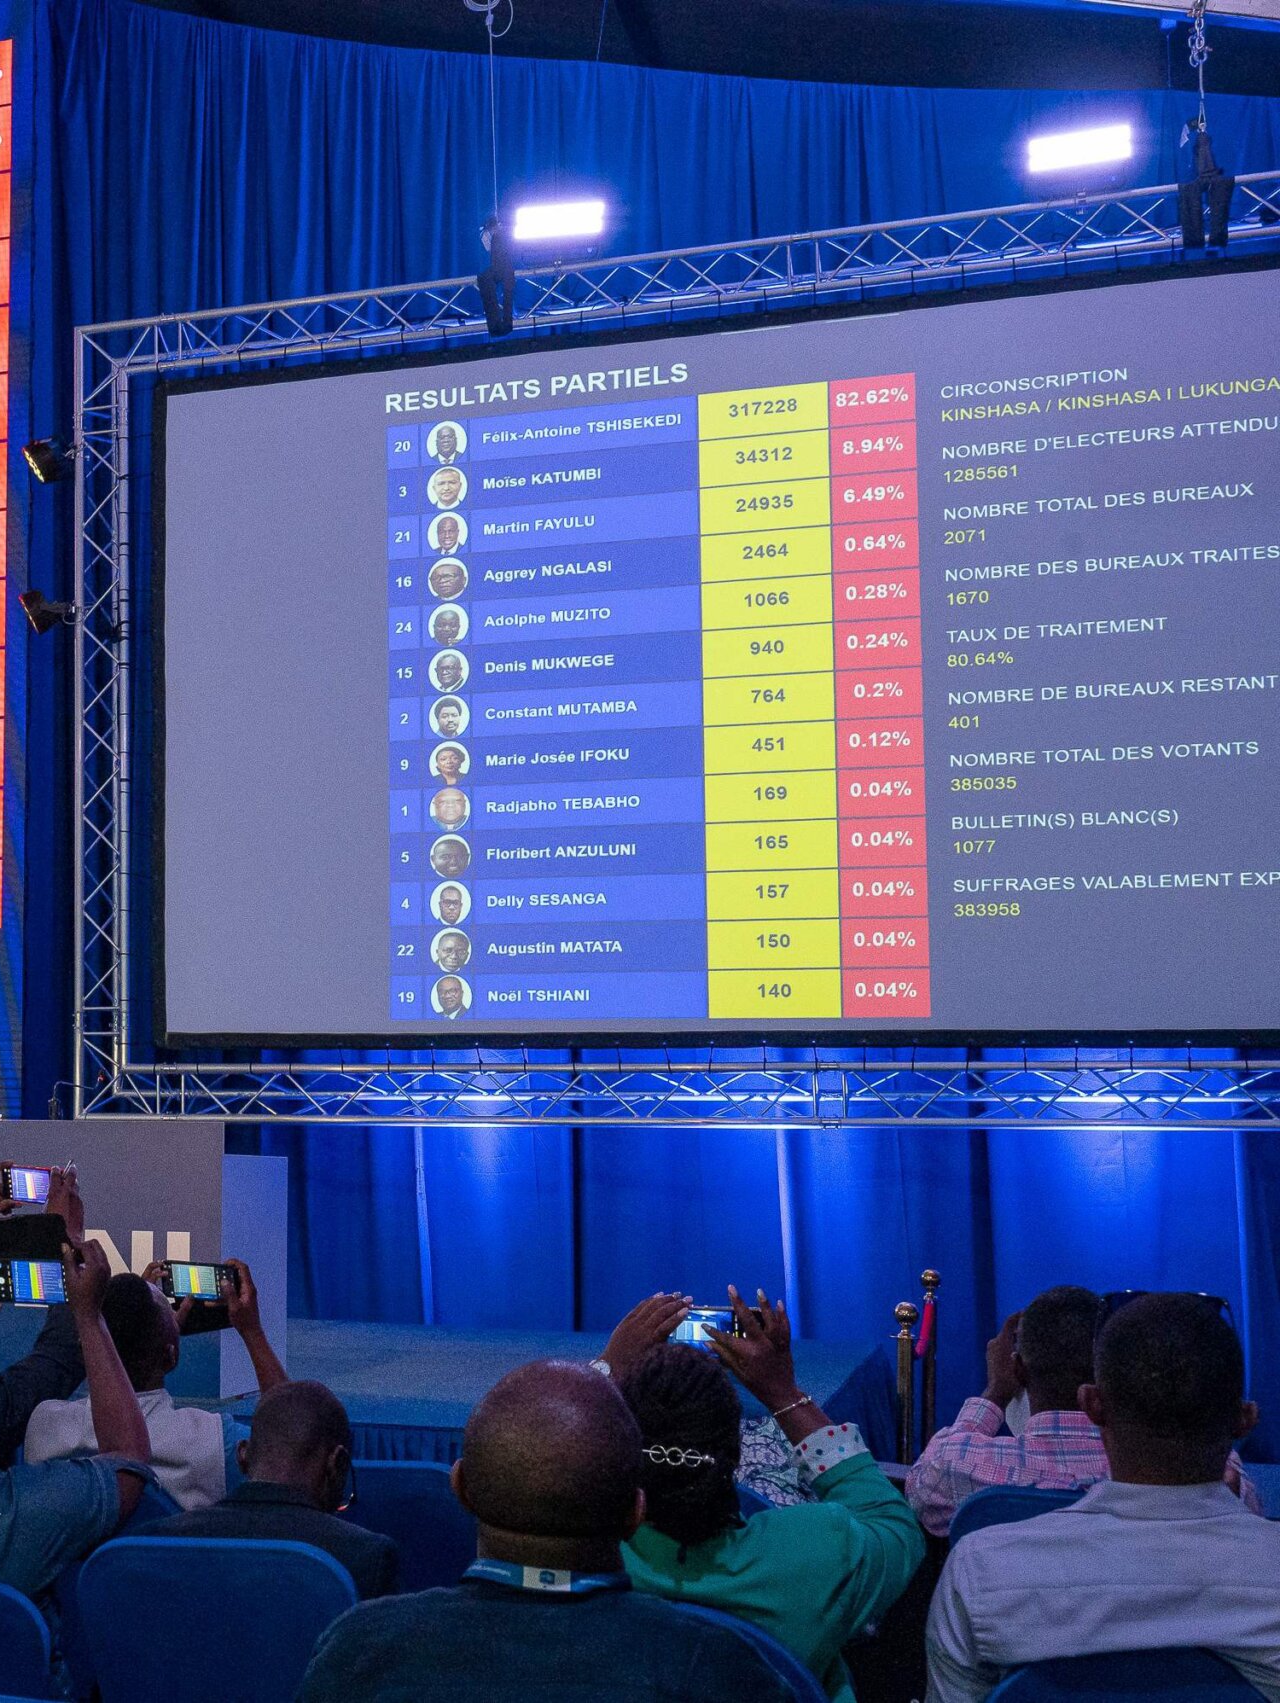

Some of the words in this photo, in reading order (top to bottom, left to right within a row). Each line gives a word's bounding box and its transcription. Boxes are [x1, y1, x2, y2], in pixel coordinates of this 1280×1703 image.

[386, 380, 540, 413] RESULTATS
[551, 364, 687, 395] PARTIELS
[940, 367, 1127, 399] CIRCONSCRIPTION
[395, 441, 410, 452] 20
[483, 426, 580, 443] Félix-Antoine
[588, 414, 680, 432] TSHISEKEDI
[729, 398, 797, 417] 317228
[836, 388, 908, 407] 82.62%
[400, 486, 406, 497] 3
[484, 478, 526, 489] Moïse
[532, 469, 600, 484] KATUMBI
[736, 447, 792, 464] 34312
[843, 437, 903, 454] 8.94%
[396, 532, 409, 542] 21
[484, 522, 529, 534] Martin
[535, 516, 594, 530] FAYULU
[737, 494, 793, 512] 24935
[844, 486, 904, 502] 6.49%
[947, 628, 996, 642] TAUX
[1004, 626, 1029, 639] DE
[1037, 618, 1166, 637] TRAITEMENT
[947, 652, 1013, 667] 80.64%
[401, 760, 408, 770] 9
[486, 755, 525, 765] Marie
[531, 753, 575, 764] Josée
[581, 749, 629, 761] IFOKU
[752, 738, 784, 751] 451
[849, 732, 910, 747] 0.12%
[950, 752, 1035, 767] NOMBRE
[1043, 749, 1104, 762] TOTAL
[1113, 746, 1153, 760] DES
[1161, 742, 1258, 758] VOTANTS
[951, 777, 1016, 791] 385035
[952, 813, 1074, 829] BULLETIN(S)
[1082, 810, 1178, 825] BLANC(S)
[954, 840, 995, 853] 1077
